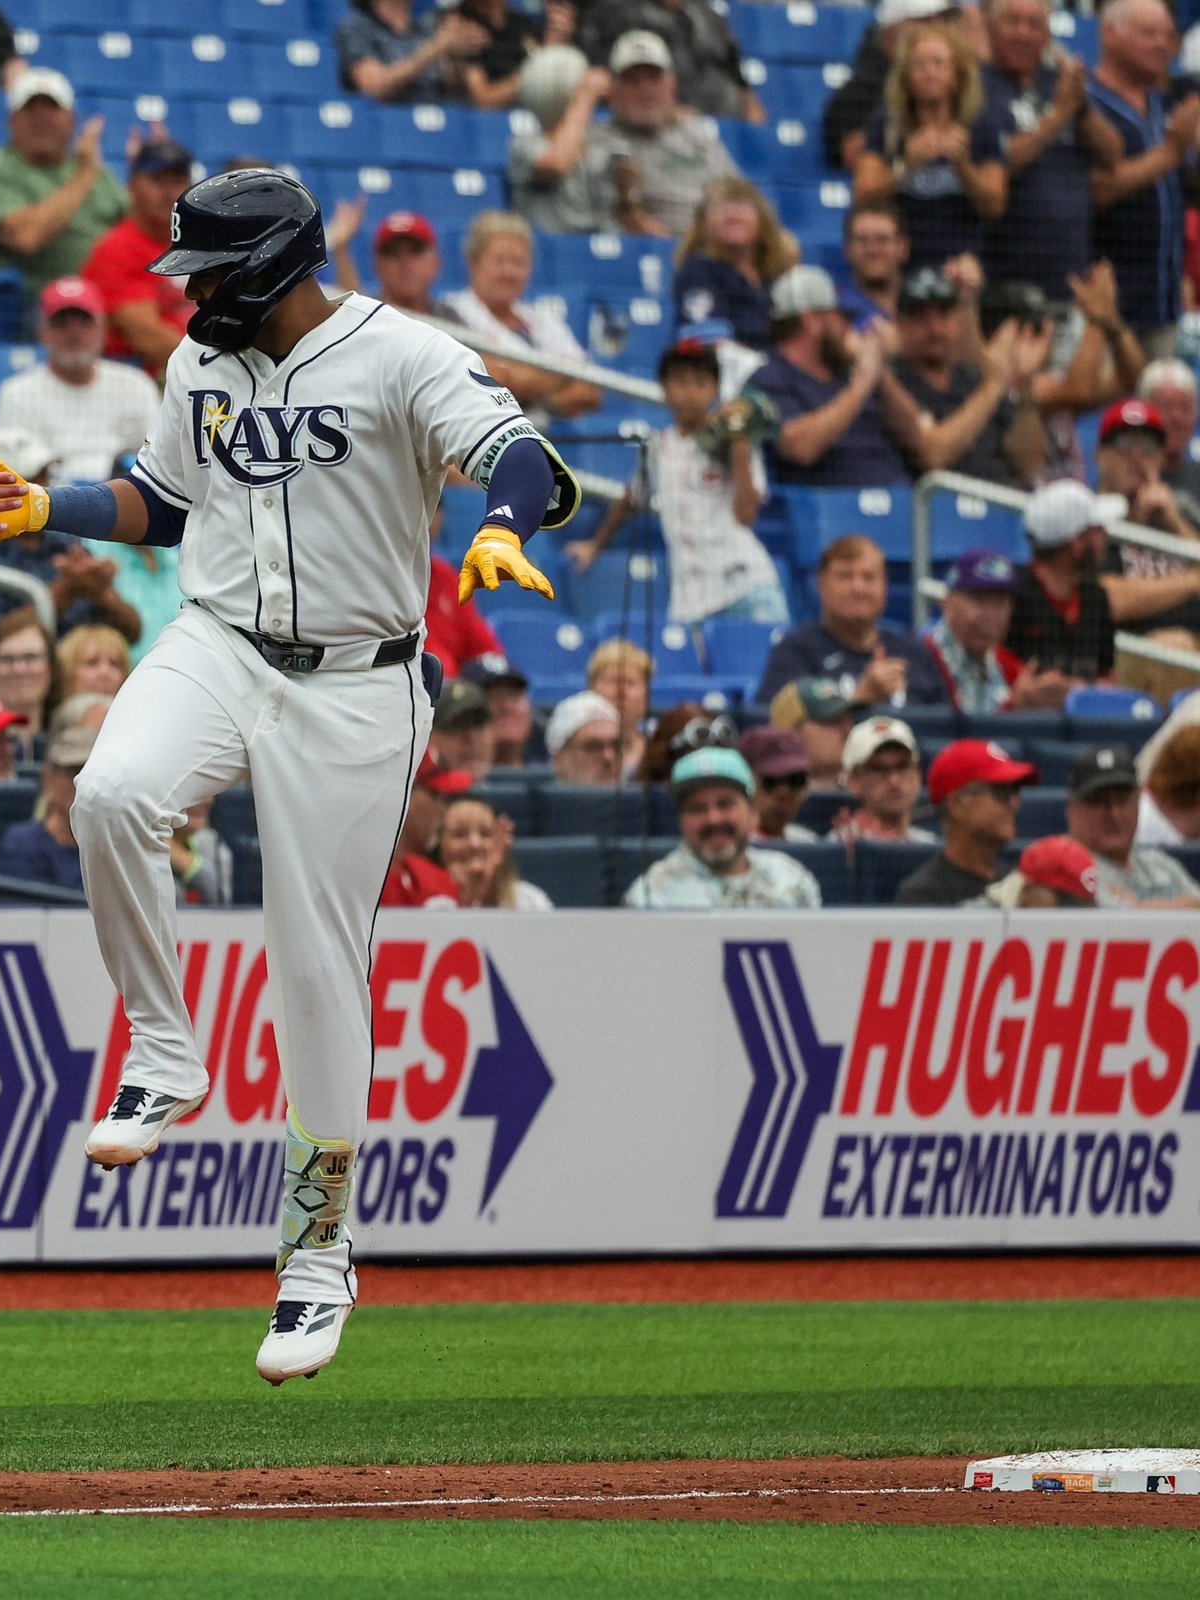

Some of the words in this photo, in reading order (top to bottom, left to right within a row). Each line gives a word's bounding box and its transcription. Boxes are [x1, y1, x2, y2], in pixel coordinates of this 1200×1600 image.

[188, 390, 352, 488] RAYS
[839, 937, 1200, 1118] HUGHES
[326, 1155, 348, 1175] JC
[821, 1131, 1179, 1219] EXTERMINATORS
[319, 1222, 339, 1242] JC
